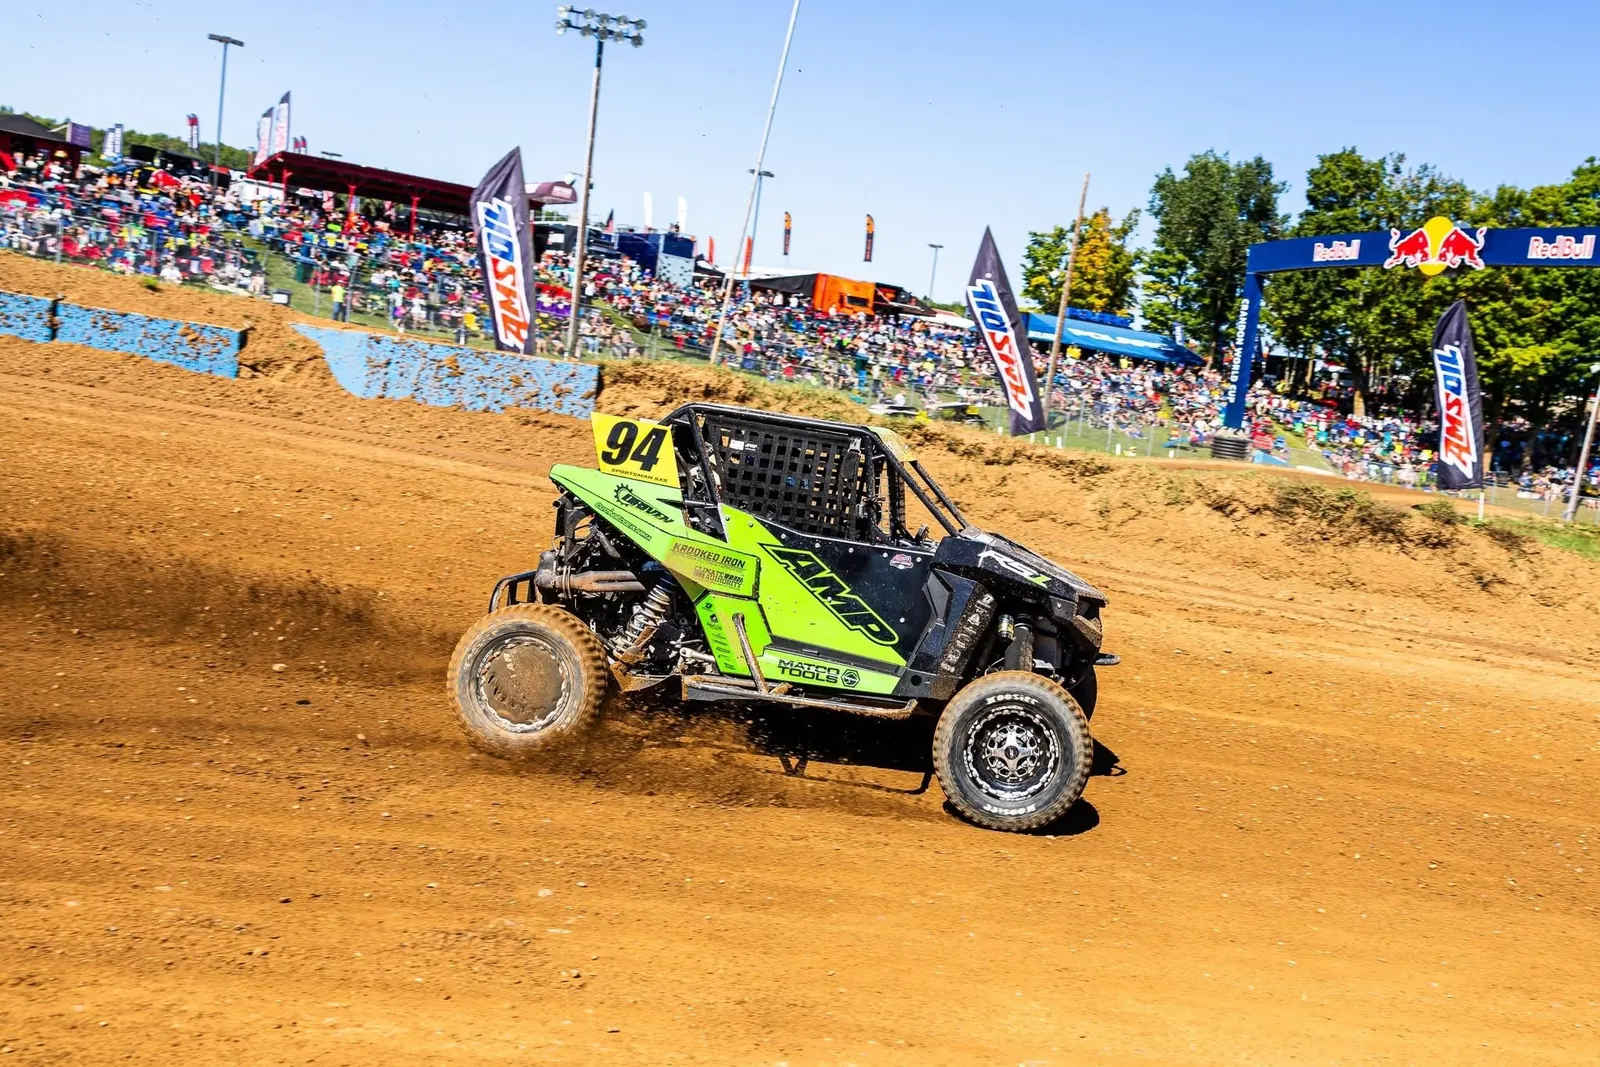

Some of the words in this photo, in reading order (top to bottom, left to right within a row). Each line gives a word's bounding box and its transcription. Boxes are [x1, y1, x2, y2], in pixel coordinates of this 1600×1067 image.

[480, 200, 530, 347] AMSOIL
[1235, 298, 1250, 345] CRANDON
[970, 281, 1031, 416] AMSOIL
[1230, 347, 1243, 383] WORLD
[1227, 384, 1237, 403] CUP
[1435, 347, 1475, 474] AMSOIL
[601, 421, 668, 472] 94
[611, 468, 653, 480] SPORTSMAN
[672, 543, 720, 562] KROOKED
[721, 555, 746, 569] IRON
[757, 542, 899, 645] AMP
[777, 665, 839, 684] TOOLS
[778, 659, 840, 675] MATCO
